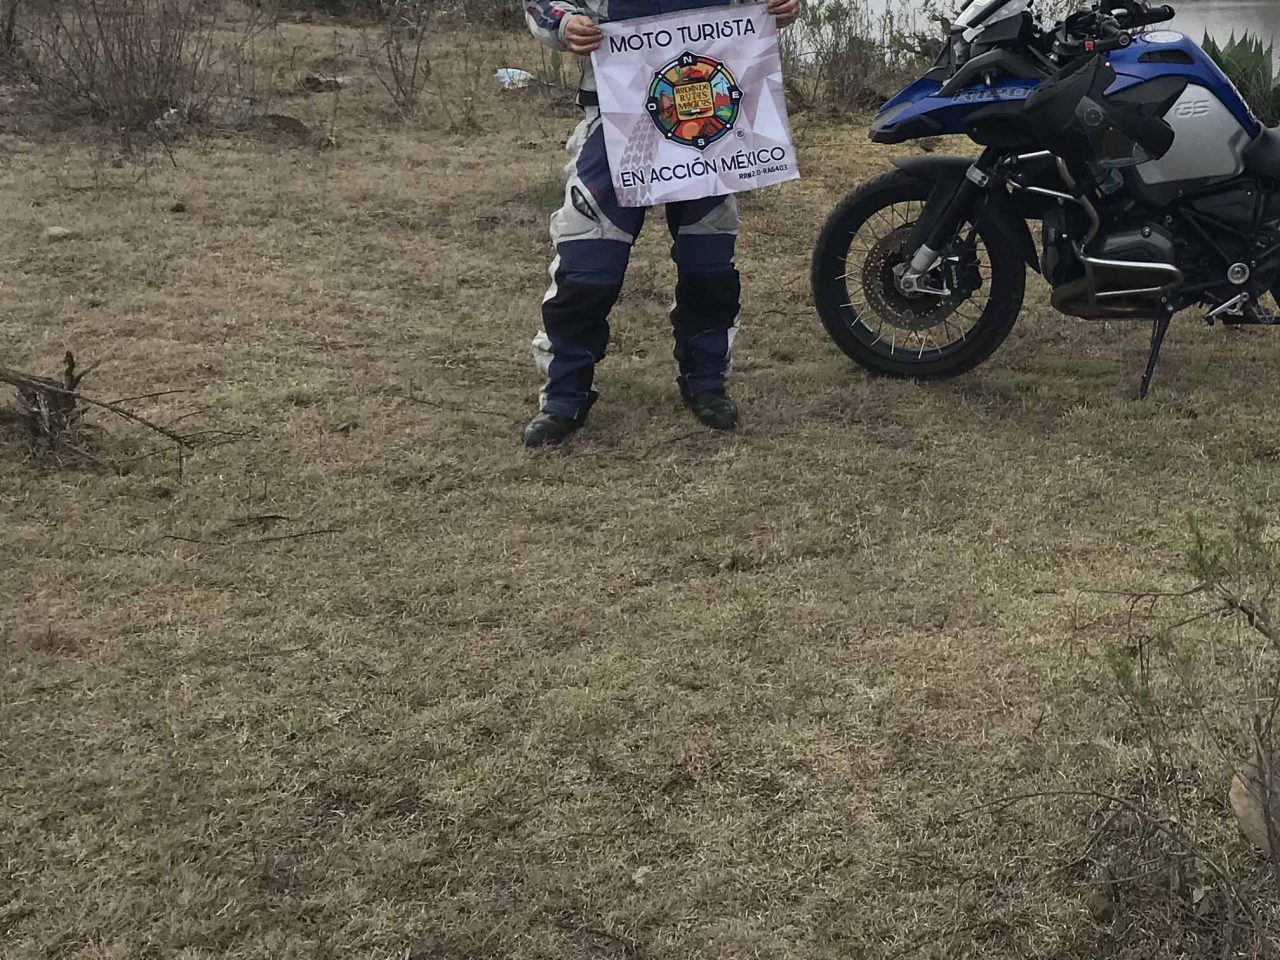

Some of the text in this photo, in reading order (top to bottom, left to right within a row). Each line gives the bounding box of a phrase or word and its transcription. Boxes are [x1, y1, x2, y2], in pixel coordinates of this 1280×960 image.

[609, 17, 756, 54] MOTO TURISTA
[683, 55, 693, 64] N
[679, 91, 708, 102] RUTAS
[732, 91, 740, 99] E
[647, 103, 657, 111] O
[1174, 99, 1210, 118] GS
[697, 138, 705, 146] S
[620, 146, 786, 188] EN ACCIÓN MÉXICO
